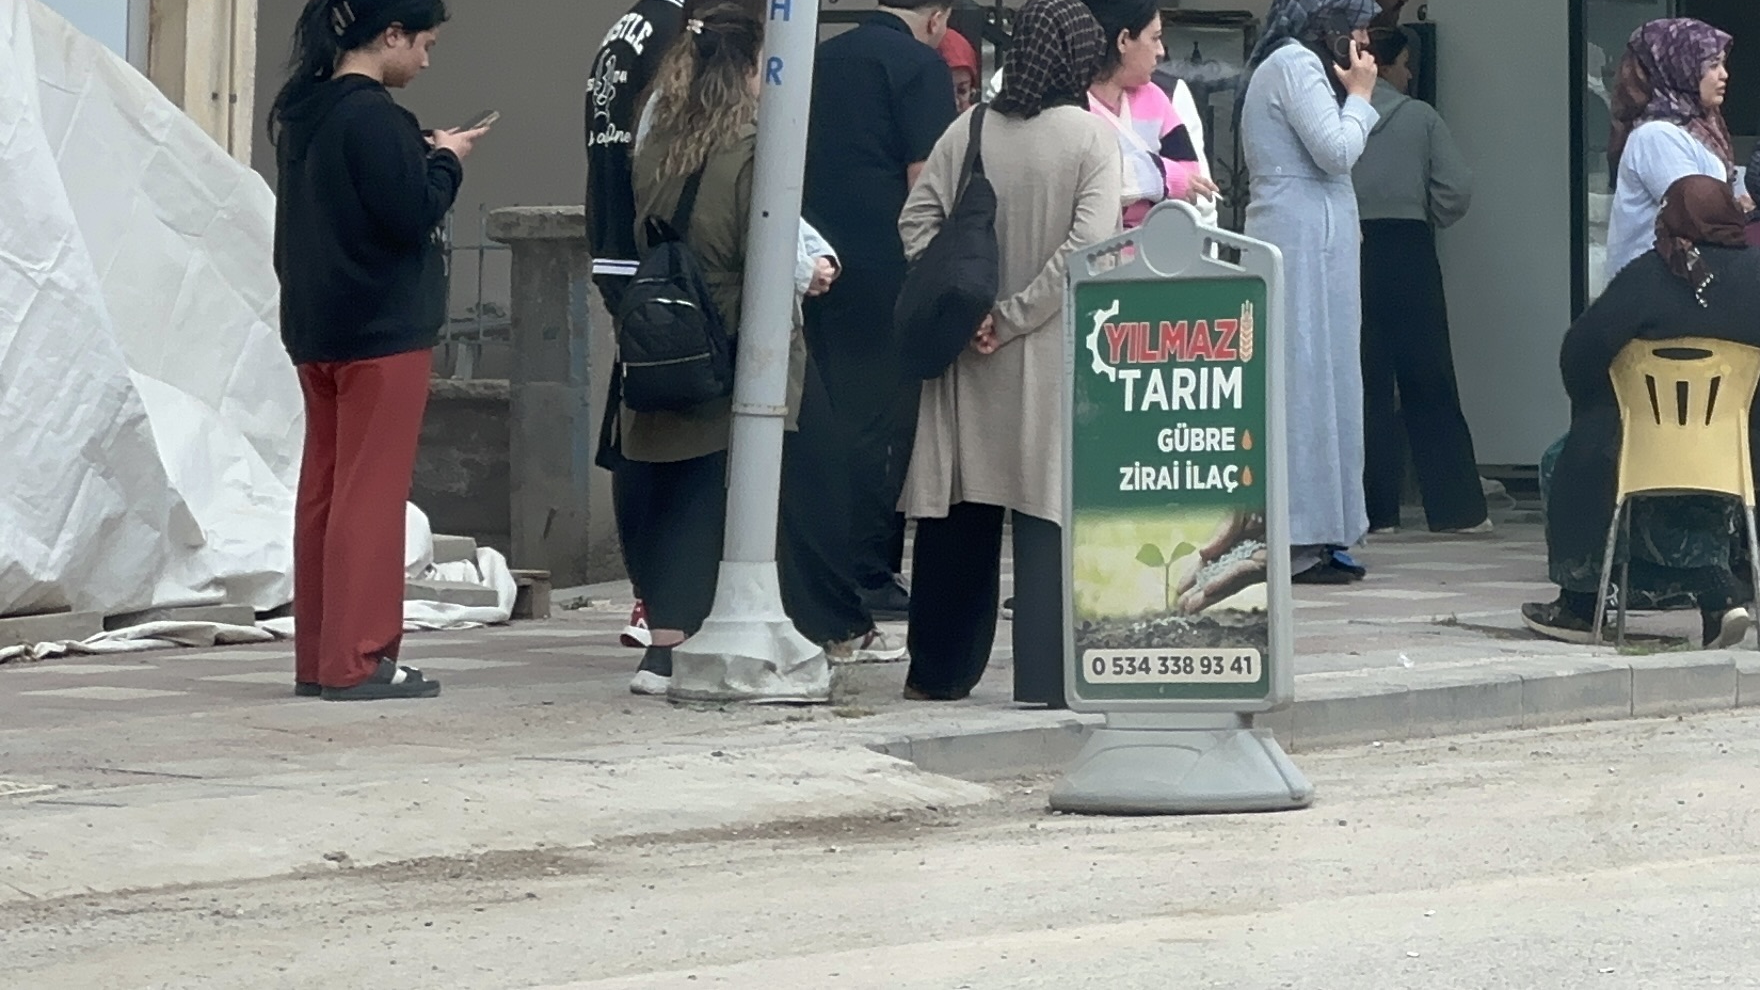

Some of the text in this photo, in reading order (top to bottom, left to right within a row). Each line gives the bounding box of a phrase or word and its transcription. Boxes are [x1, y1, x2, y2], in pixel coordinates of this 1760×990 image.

[1103, 319, 1238, 364] YILMAZ
[1118, 366, 1243, 411] TARIM
[1157, 422, 1236, 452] GÜBRE
[1119, 460, 1239, 493] ZİRAİ İLAÇ
[1092, 656, 1252, 675] 0 534 338 93 41
